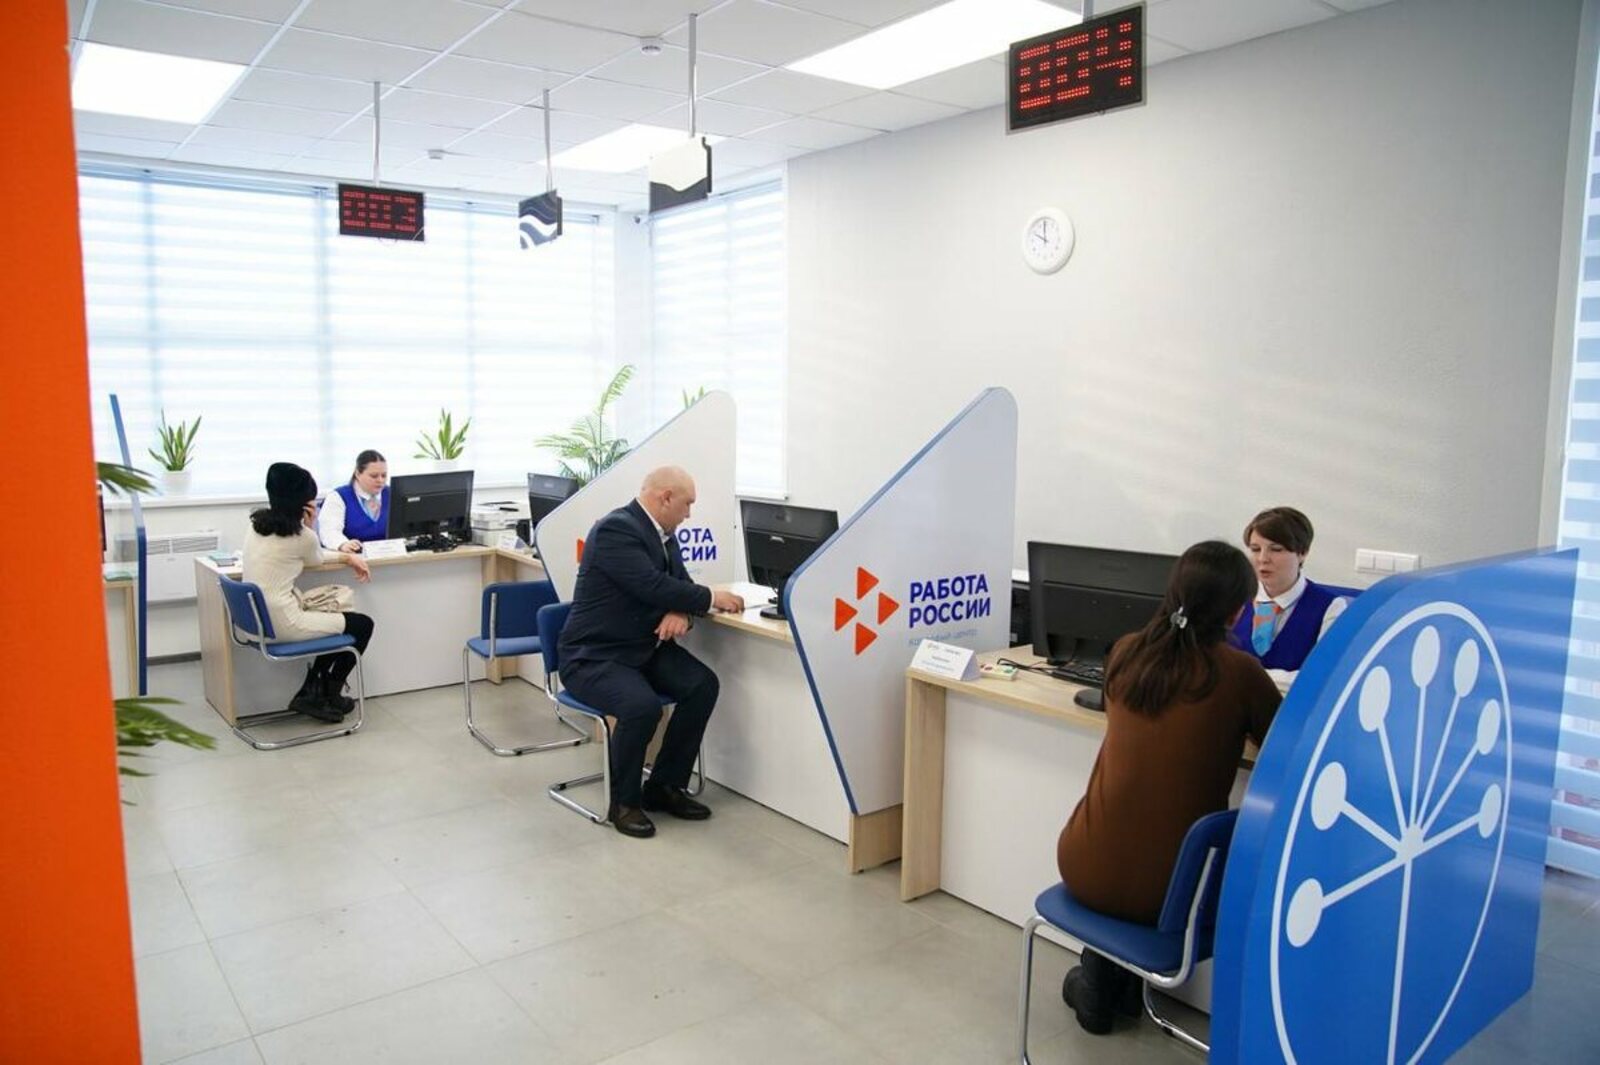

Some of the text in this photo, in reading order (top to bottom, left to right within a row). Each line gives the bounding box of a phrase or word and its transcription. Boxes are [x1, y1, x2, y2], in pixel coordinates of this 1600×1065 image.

[1019, 22, 1133, 109] 004
[343, 191, 416, 232] 003
[678, 528, 713, 544] ОТА
[680, 545, 716, 562] СИИ
[910, 573, 988, 603] РАБОТА
[909, 597, 990, 629] РОССИИ
